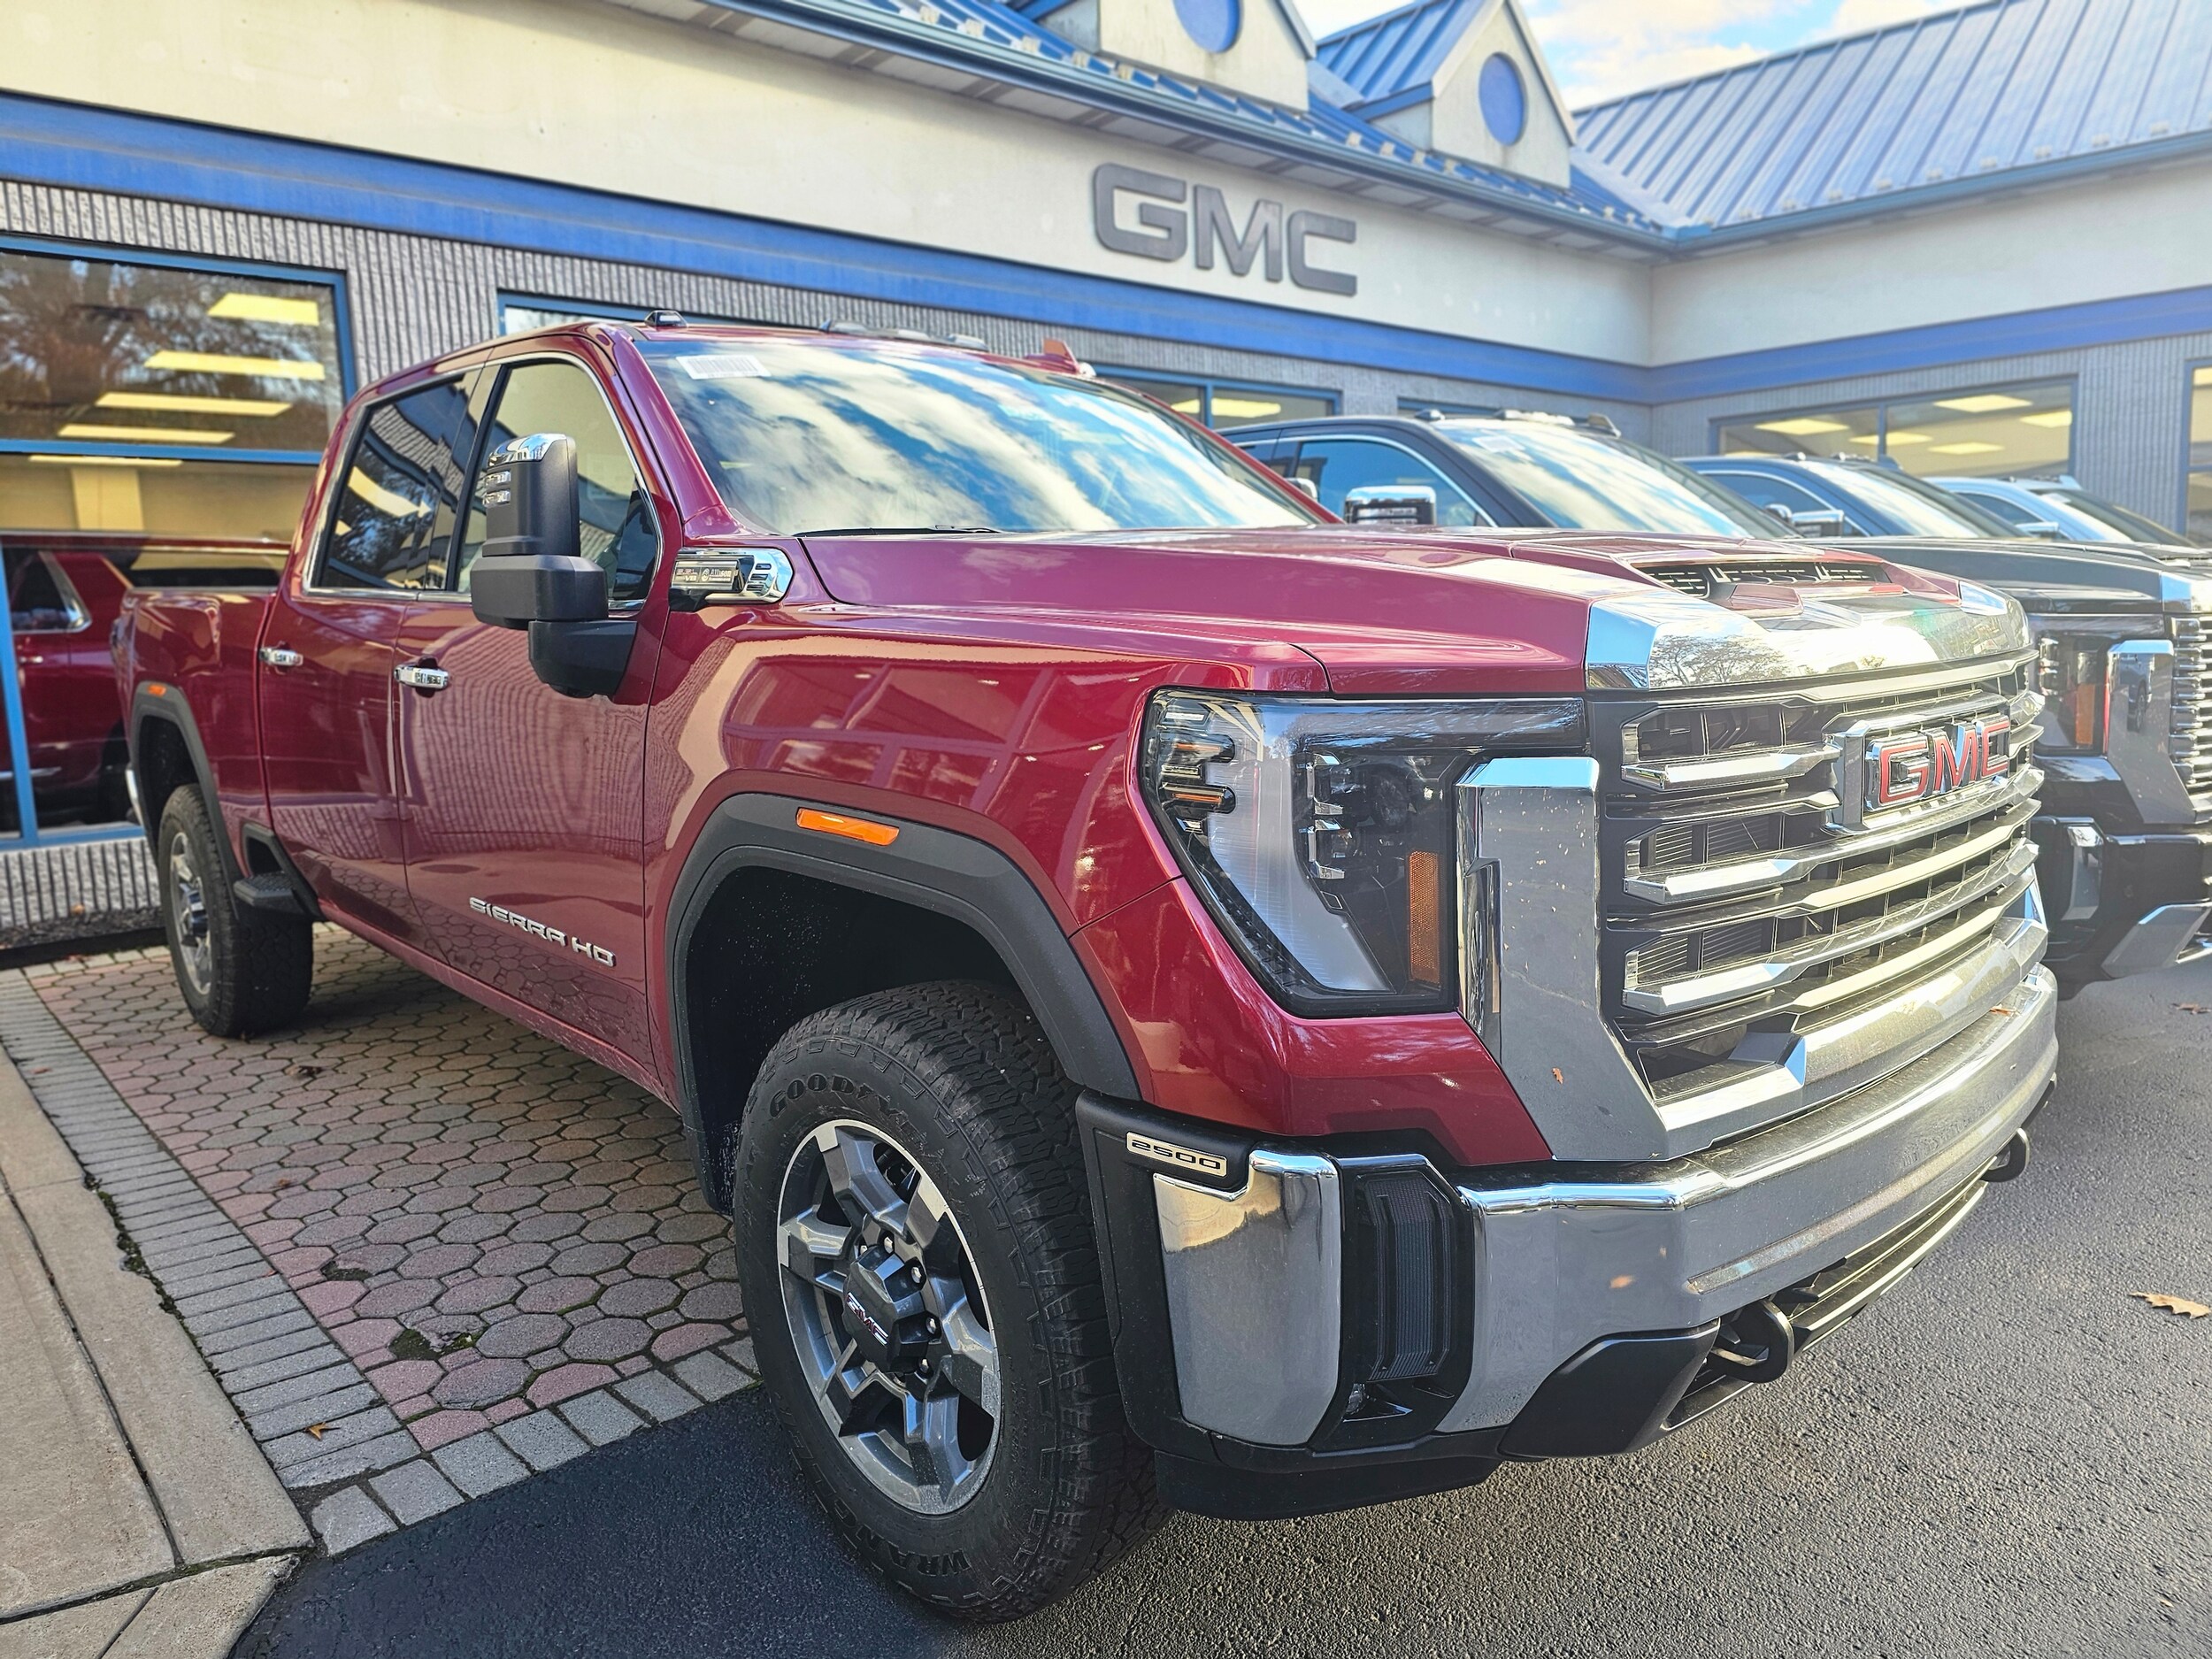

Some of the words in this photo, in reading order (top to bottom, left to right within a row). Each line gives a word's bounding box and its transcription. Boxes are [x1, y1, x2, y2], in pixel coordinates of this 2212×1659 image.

[1093, 162, 1357, 297] GMC
[1870, 716, 2010, 809] GMC
[469, 896, 567, 947] SIERRA
[572, 936, 616, 967] HD
[1132, 1139, 1220, 1170] 2500
[846, 1292, 888, 1345] GMC
